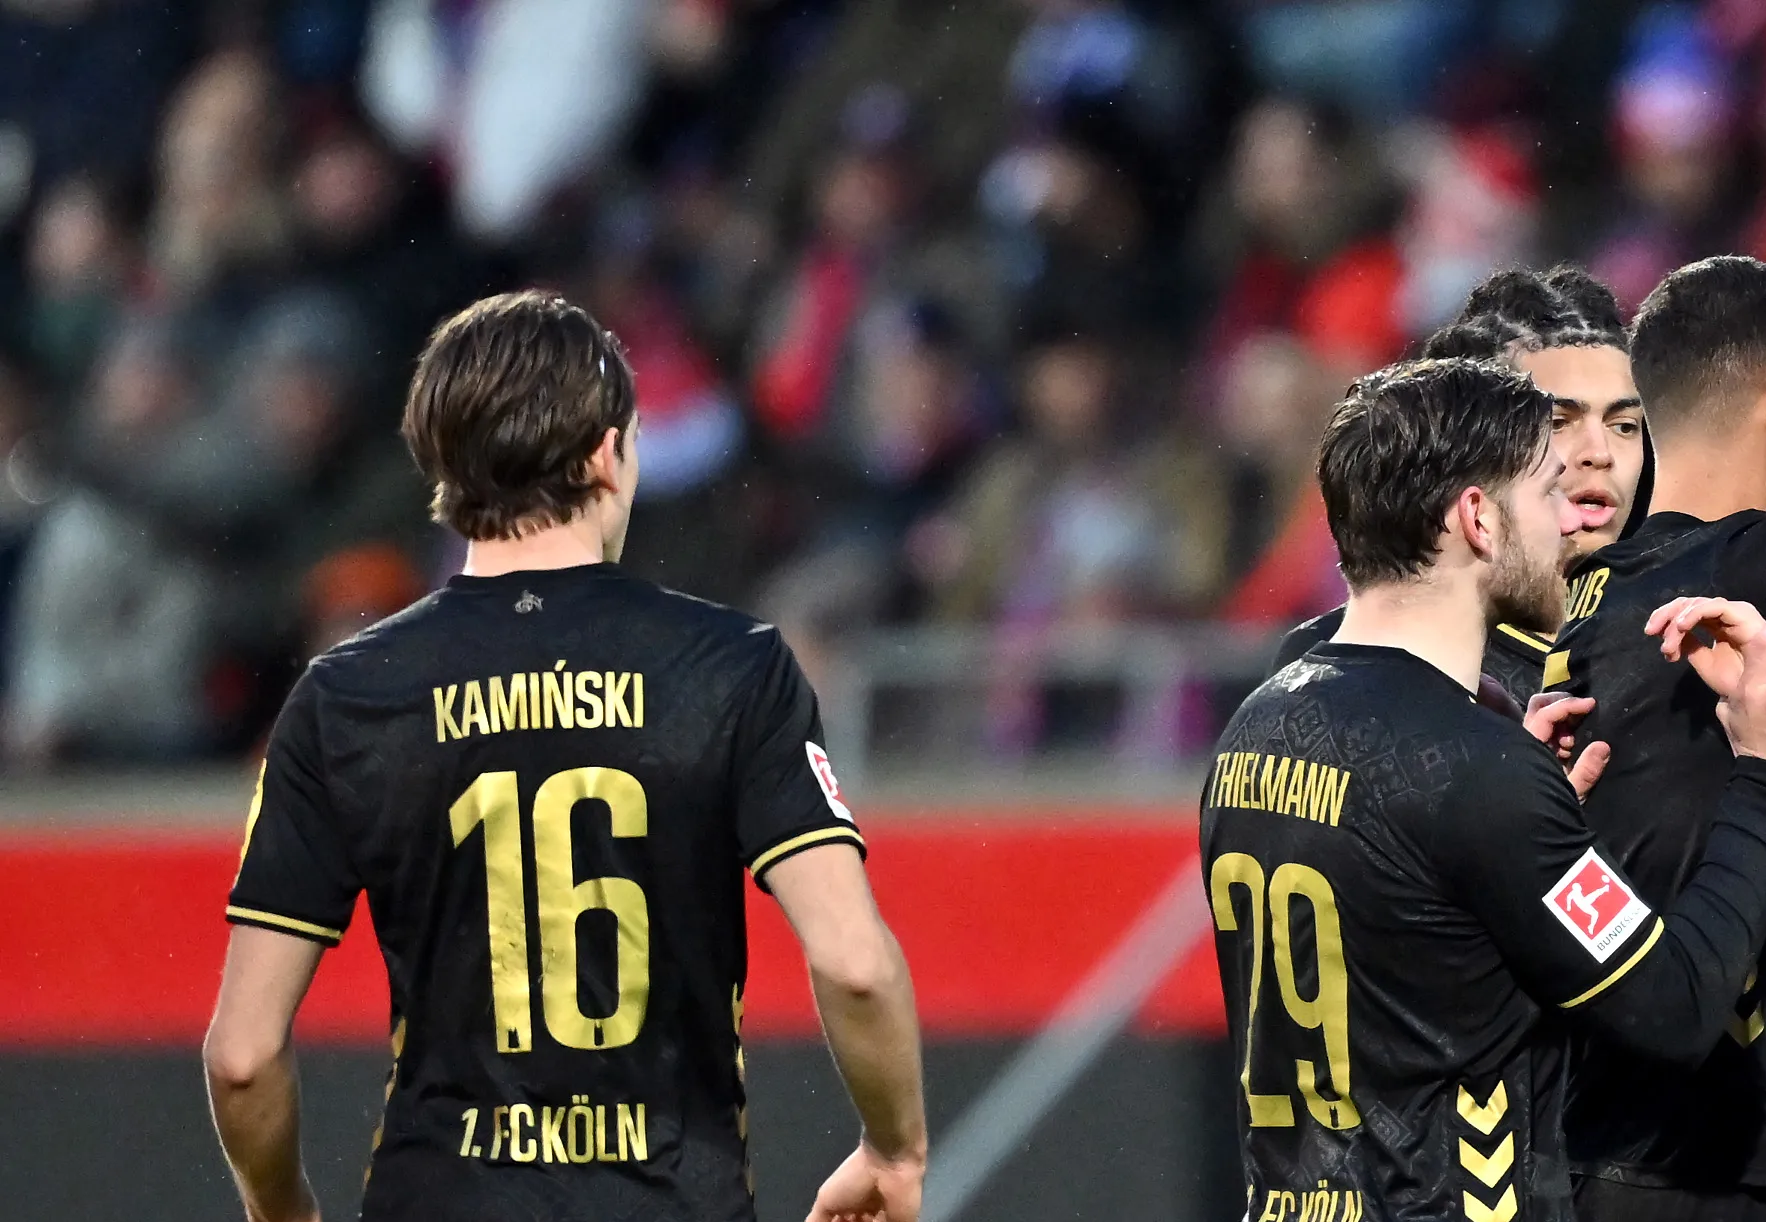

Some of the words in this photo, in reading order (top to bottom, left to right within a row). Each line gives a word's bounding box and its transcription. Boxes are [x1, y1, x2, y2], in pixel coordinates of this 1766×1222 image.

[432, 659, 645, 743] KAMIŃSKI
[1209, 751, 1351, 827] THIELMANN
[449, 766, 650, 1053] 16
[1210, 852, 1362, 1130] 29
[459, 1107, 482, 1158] 1.
[490, 1103, 538, 1163] FC
[541, 1094, 649, 1164] KÖLN
